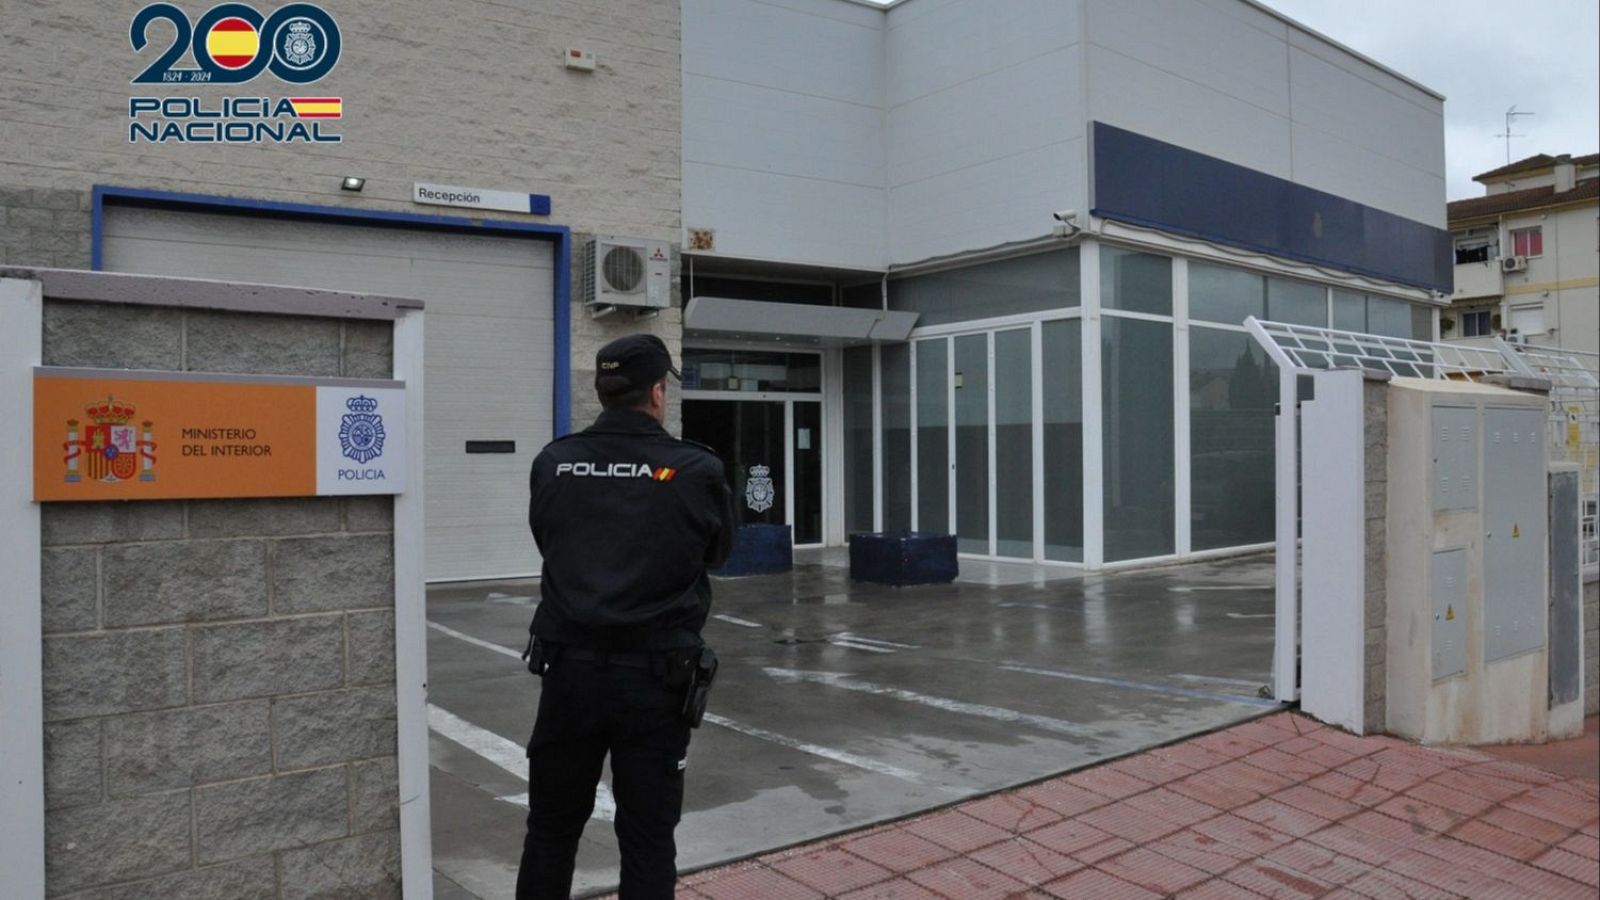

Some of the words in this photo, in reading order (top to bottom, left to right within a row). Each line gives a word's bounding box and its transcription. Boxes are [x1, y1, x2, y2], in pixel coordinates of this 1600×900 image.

[418, 187, 480, 204] Recepción
[601, 361, 620, 369] CNP
[181, 428, 257, 440] MINISTERIO
[181, 444, 207, 456] DEL
[210, 444, 272, 456] INTERIOR
[338, 469, 386, 481] POLICIA
[556, 462, 653, 477] POLICIA
